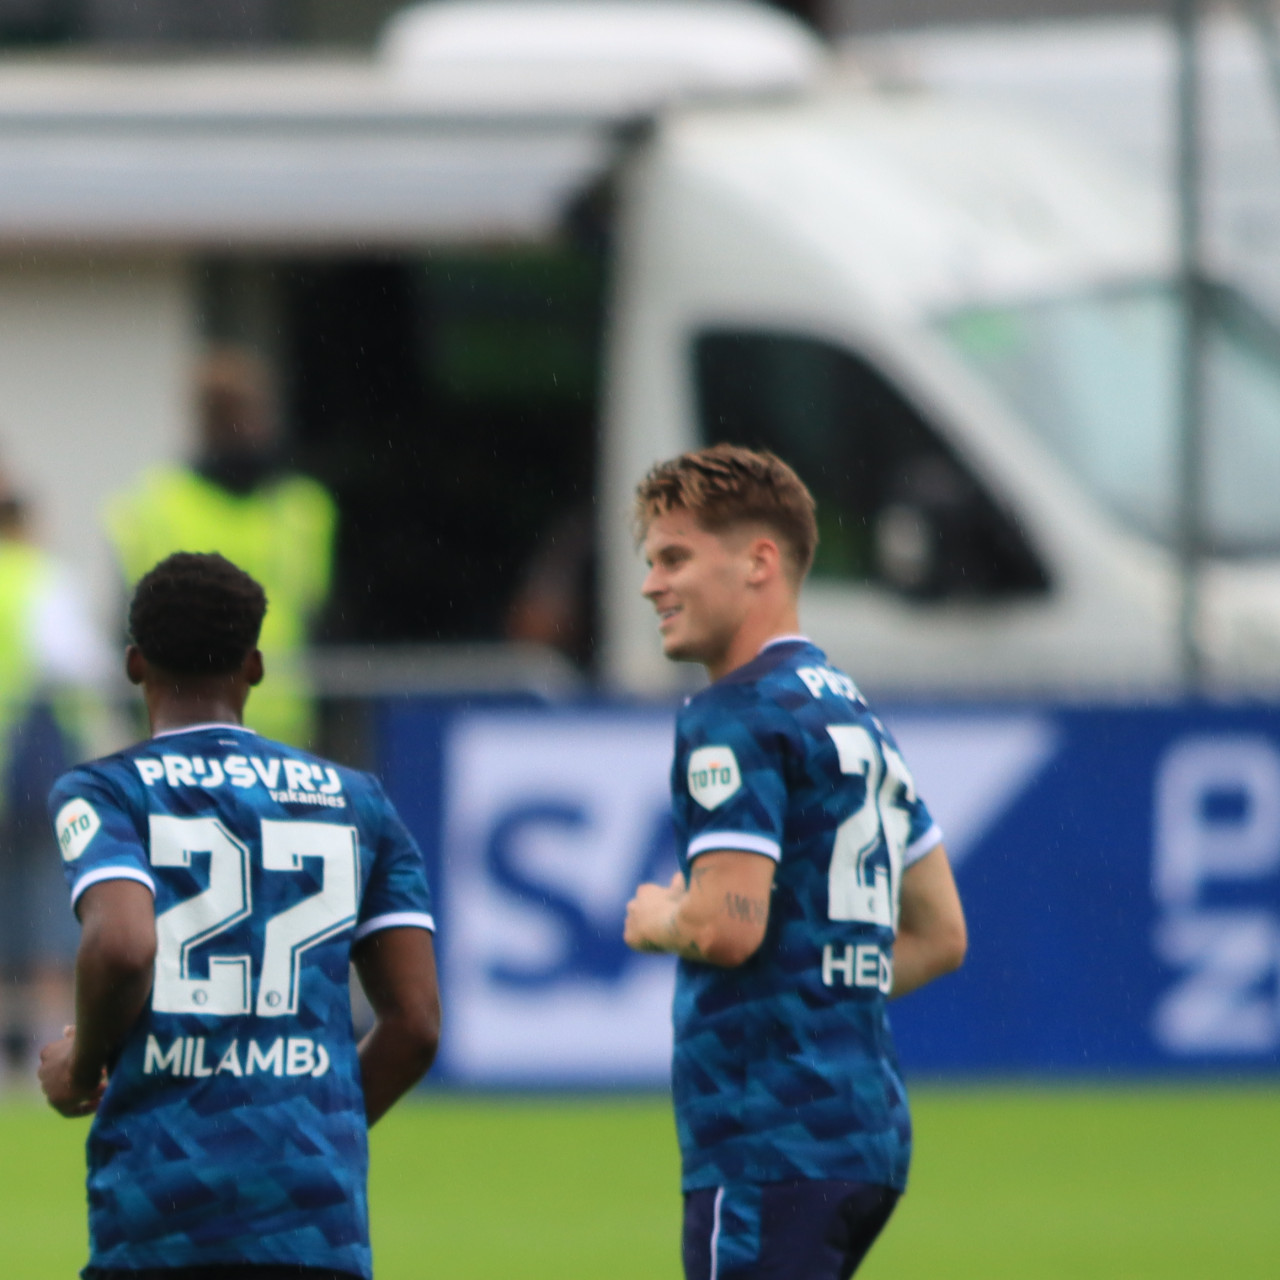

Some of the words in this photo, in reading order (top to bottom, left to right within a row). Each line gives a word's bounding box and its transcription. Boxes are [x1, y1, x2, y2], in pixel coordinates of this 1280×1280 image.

[692, 766, 731, 792] TOTO
[269, 788, 346, 808] vakanties
[148, 814, 360, 1016] 27
